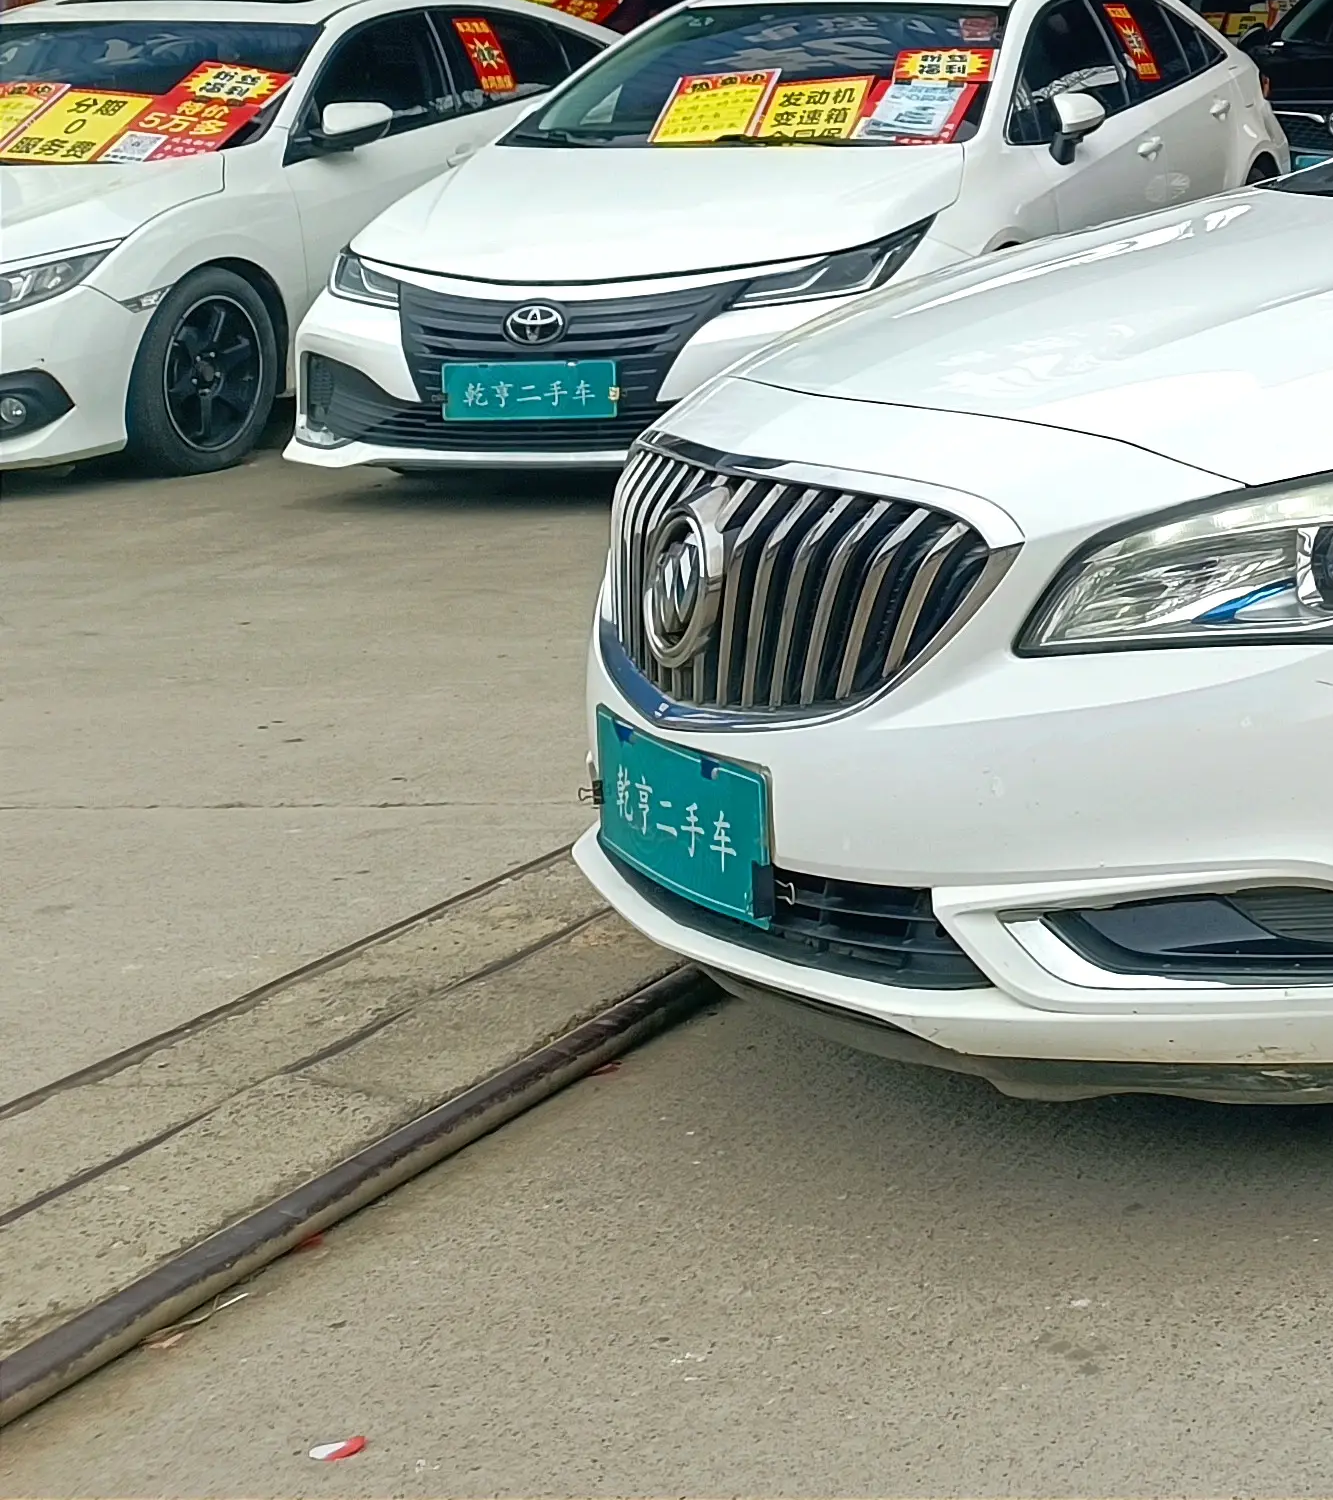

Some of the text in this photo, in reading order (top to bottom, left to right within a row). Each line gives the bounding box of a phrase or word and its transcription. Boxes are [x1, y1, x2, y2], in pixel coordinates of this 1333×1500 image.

[66, 97, 128, 117] 分期
[778, 88, 856, 107] 发动机
[176, 100, 229, 119] 特价
[770, 107, 852, 128] 变速箱
[63, 119, 88, 135] 0
[138, 111, 229, 136] 5万多
[7, 136, 97, 159] 服务费
[462, 379, 596, 409] 乾亨二手车
[616, 763, 737, 874] 乾亨二手车
